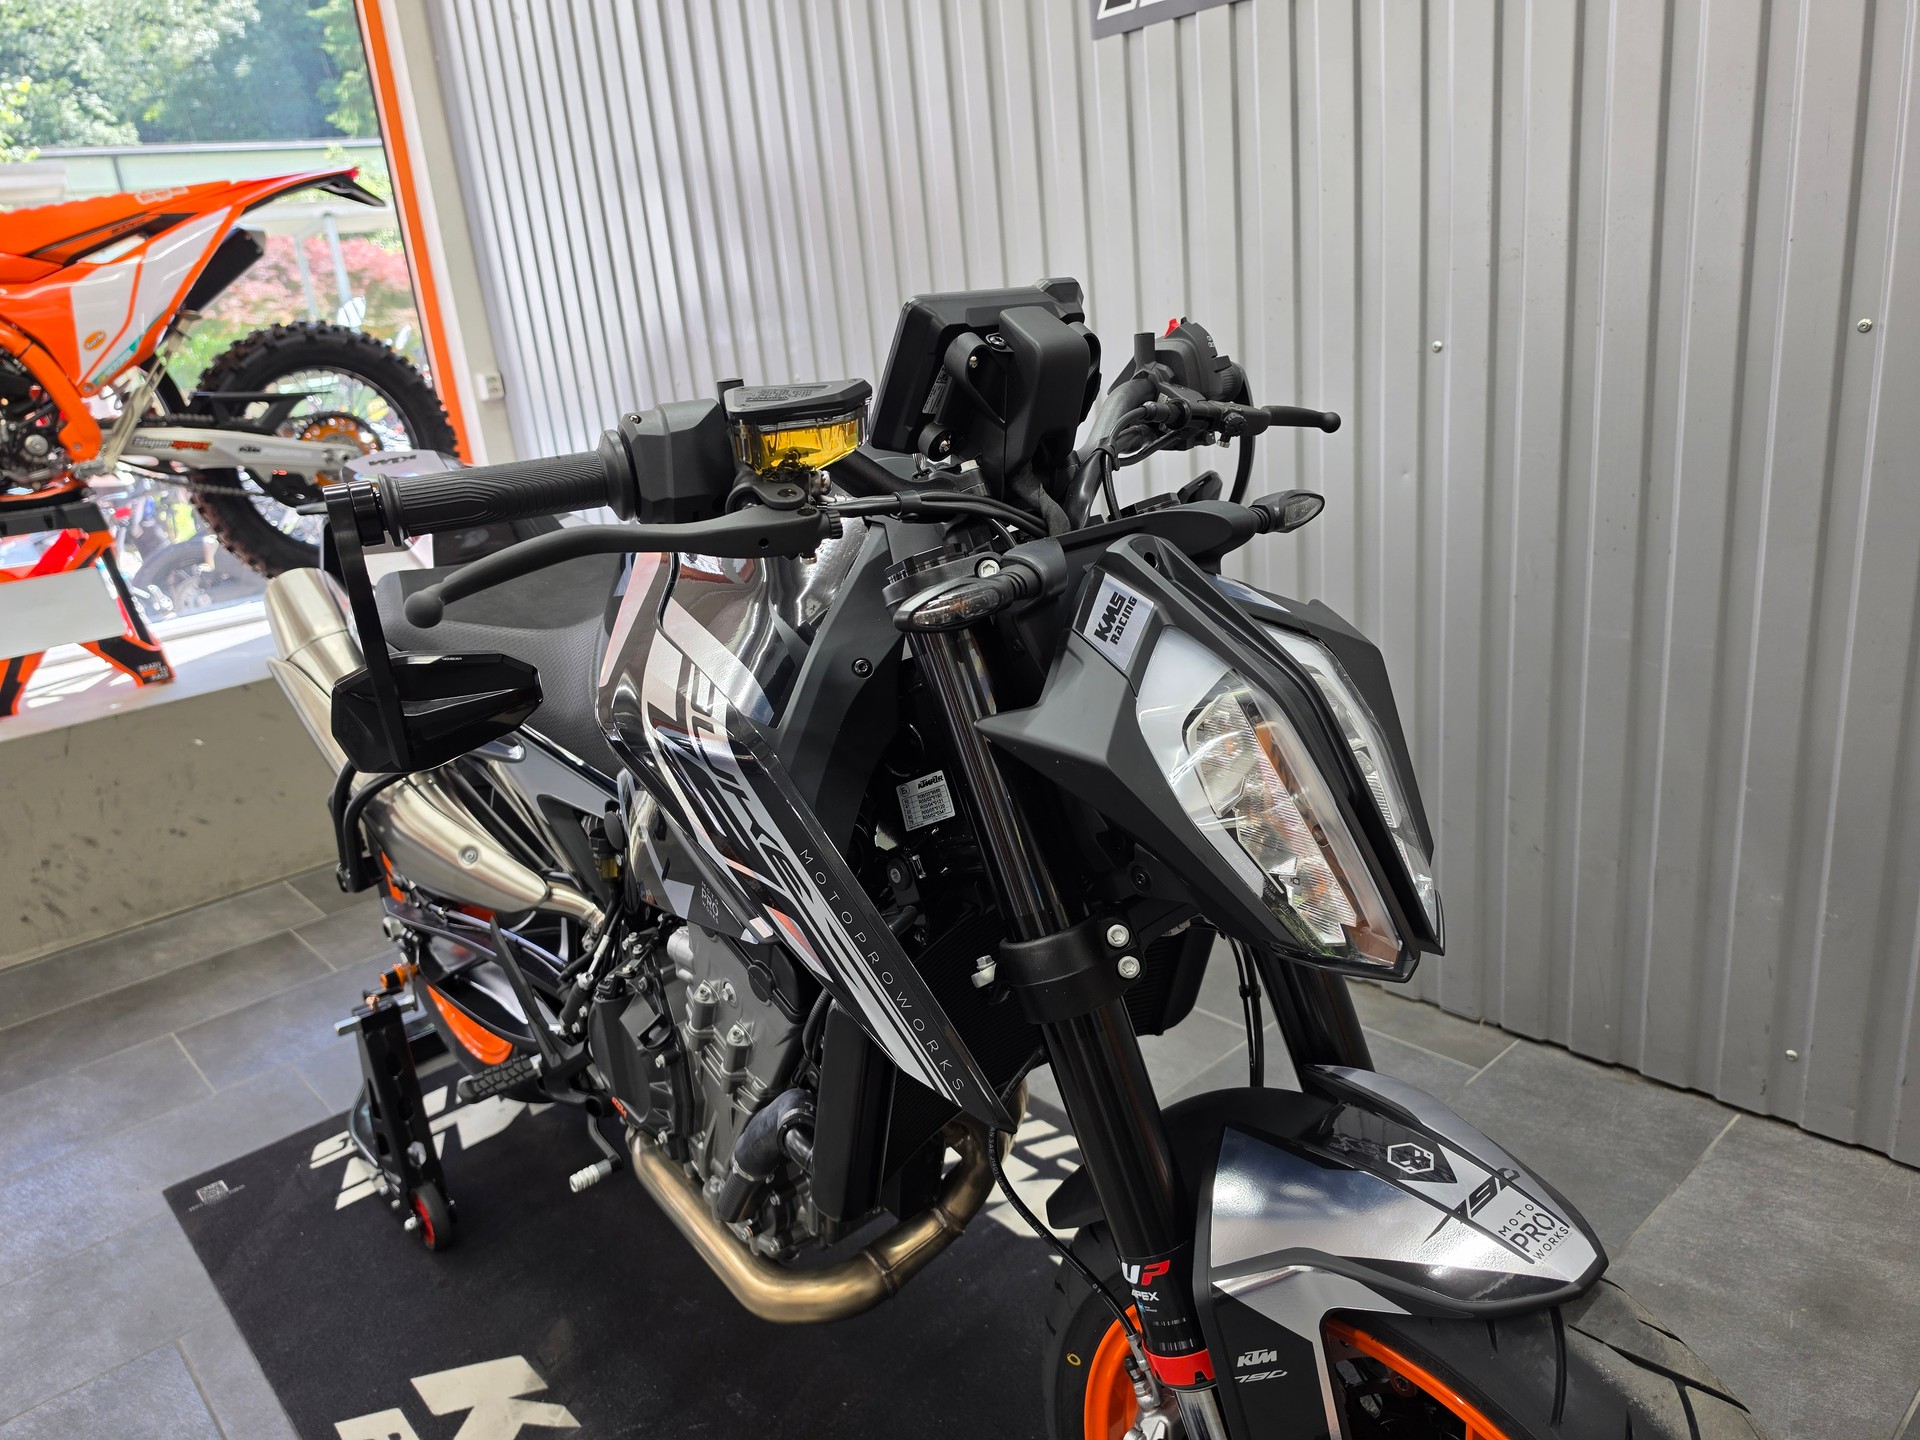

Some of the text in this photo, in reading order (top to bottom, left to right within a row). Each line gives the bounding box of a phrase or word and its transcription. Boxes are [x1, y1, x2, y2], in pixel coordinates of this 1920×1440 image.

[1093, 591, 1127, 643] KMS
[1110, 596, 1138, 646] RACING
[701, 887, 719, 917] PRO
[1033, 1224, 1048, 1239] DOT
[1498, 1203, 1535, 1237] MOTO
[1509, 1212, 1556, 1253] PRO
[1533, 1226, 1570, 1260] WORKS
[1236, 1348, 1278, 1368] KTM
[1234, 1369, 1288, 1383] 790
